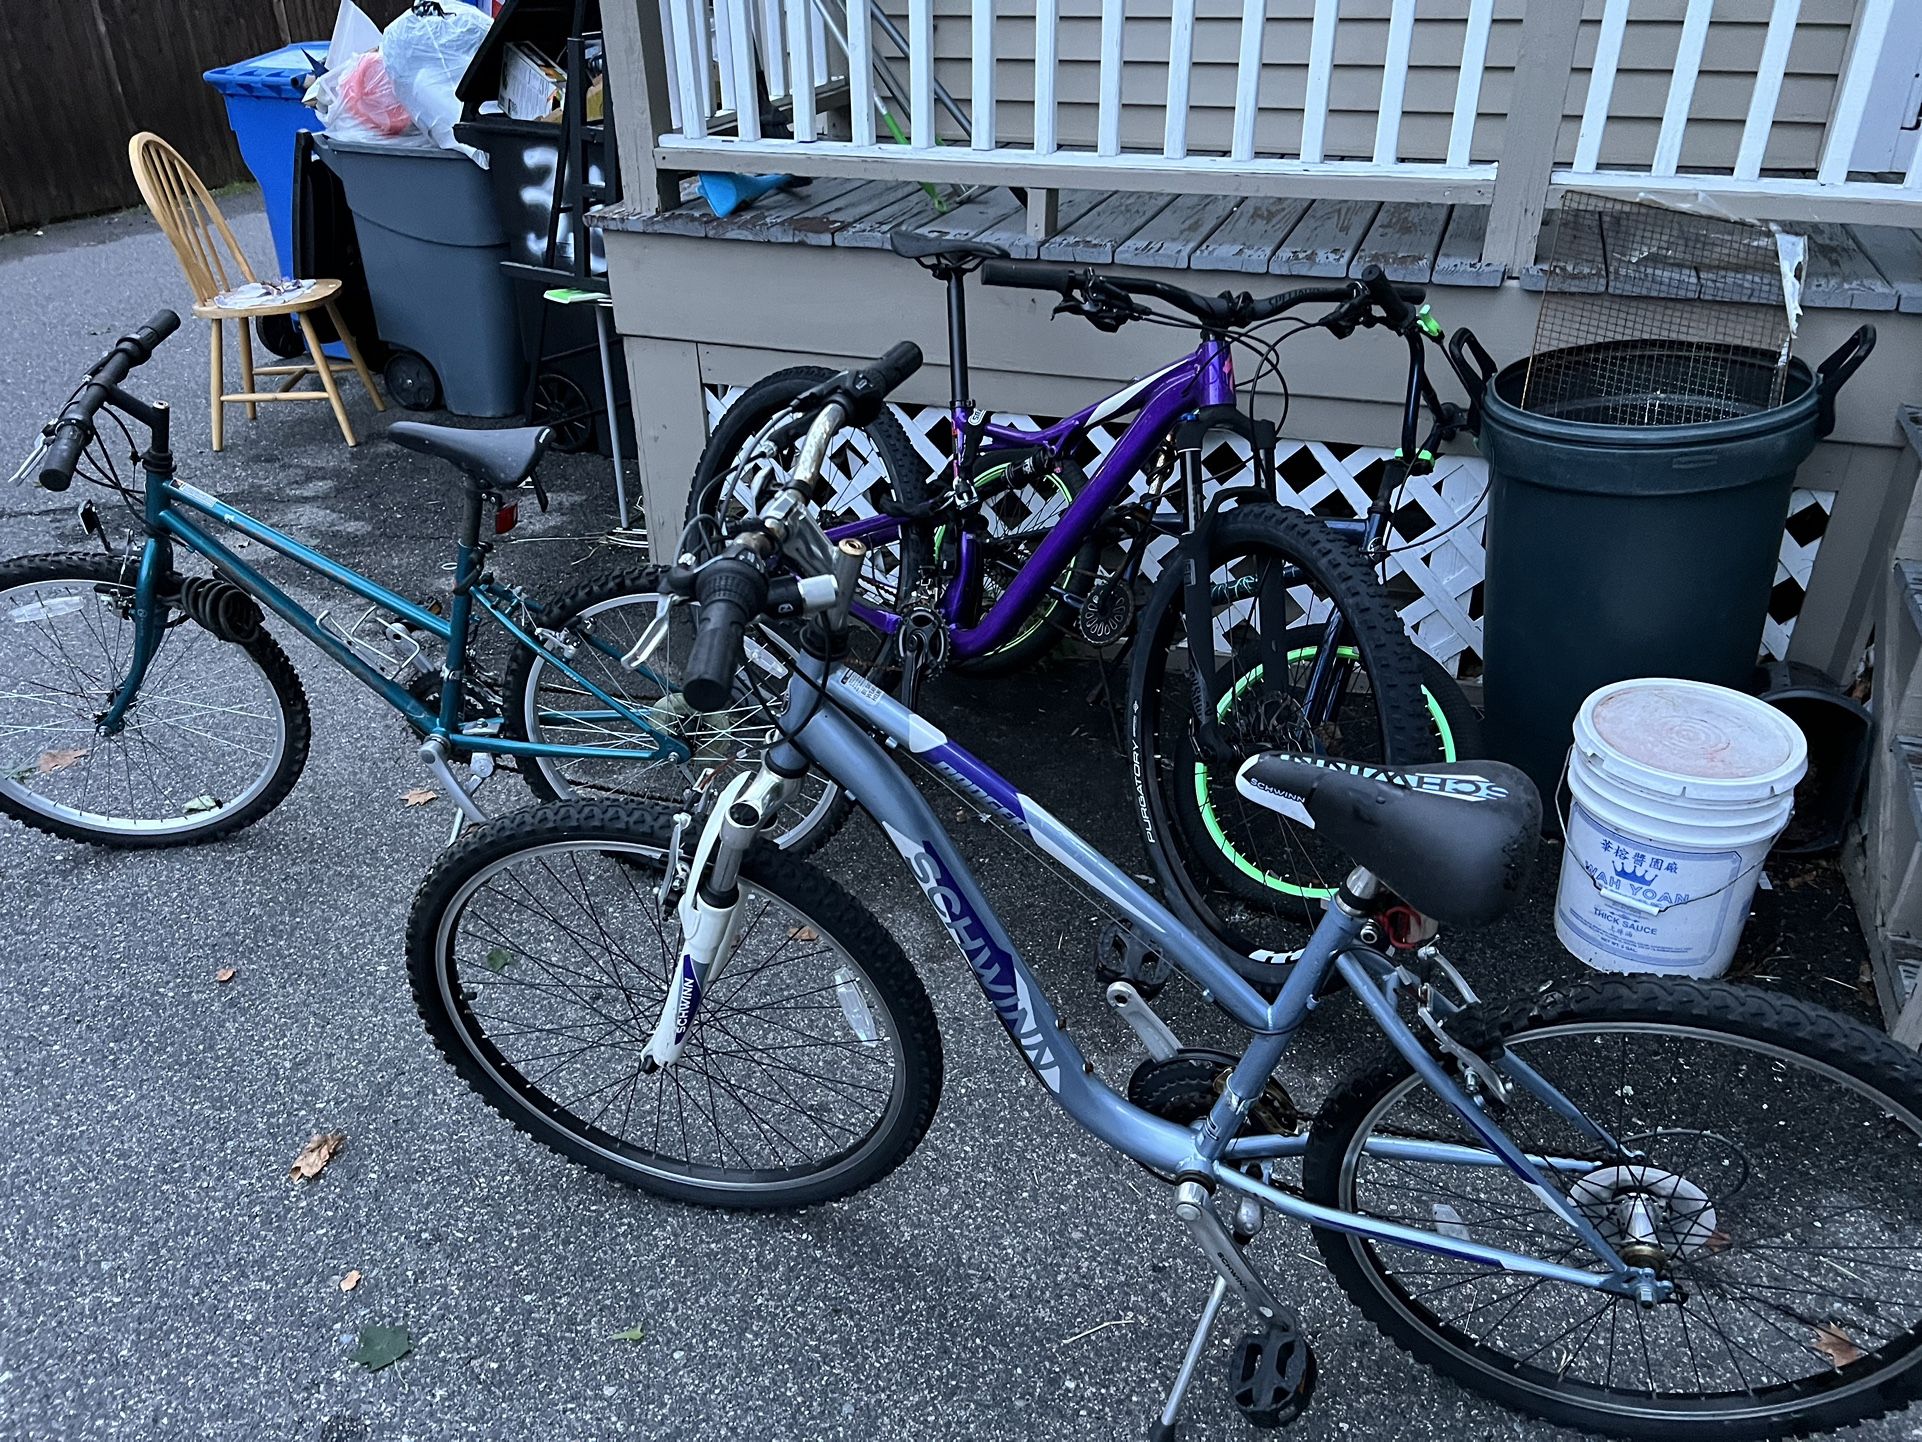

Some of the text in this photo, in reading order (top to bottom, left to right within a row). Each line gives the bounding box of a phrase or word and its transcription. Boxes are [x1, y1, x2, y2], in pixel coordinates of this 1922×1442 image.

[1132, 740, 1156, 843] PURGATORY
[1250, 777, 1306, 803] SCHWINN
[1584, 860, 1621, 890] WAH
[1629, 883, 1690, 905] YOAN
[1593, 907, 1619, 925] THICK
[1622, 920, 1658, 935] SAUCE
[913, 851, 1057, 1073] SCHWINN
[677, 977, 695, 1034] SCHWINN
[1217, 1251, 1248, 1292] SCHWINN
